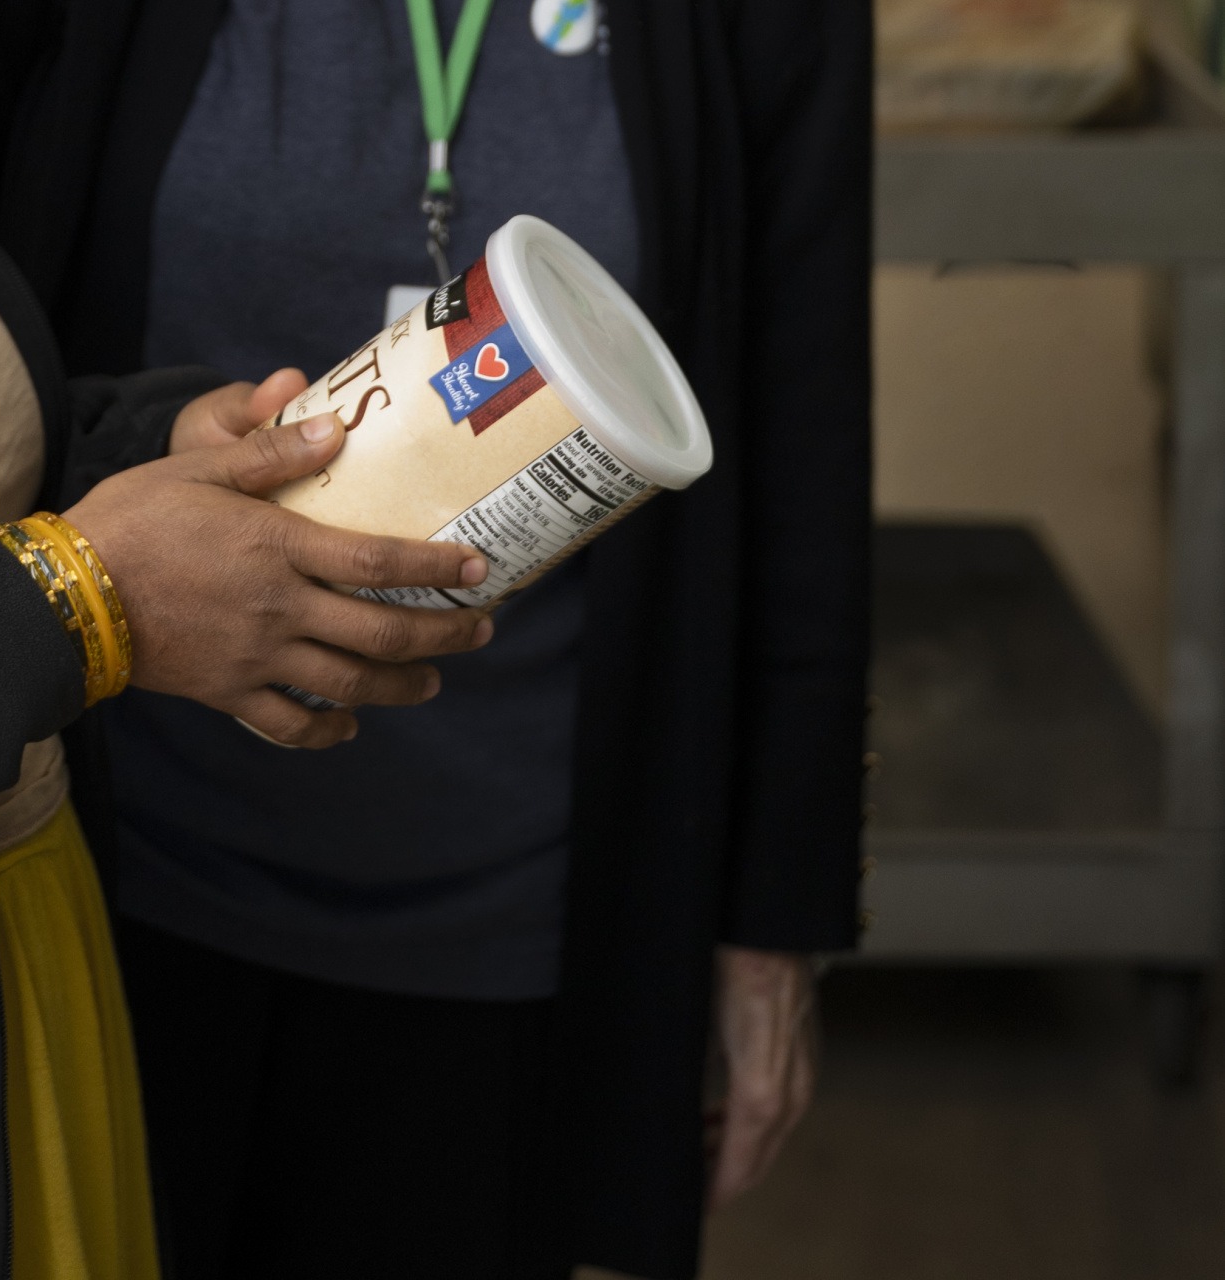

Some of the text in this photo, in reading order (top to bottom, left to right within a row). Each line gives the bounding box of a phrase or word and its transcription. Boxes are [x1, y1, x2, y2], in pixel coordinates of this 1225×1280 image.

[327, 336, 392, 432] ATS
[452, 362, 480, 402] Heart
[554, 445, 576, 470] Serving
[574, 466, 587, 479] size
[562, 440, 579, 457] about
[578, 455, 587, 464] 11
[585, 462, 608, 482] servings
[572, 429, 648, 491] Nutrition Facts
[509, 488, 532, 512] Saturated
[530, 509, 541, 519] Fat
[513, 477, 527, 493] Total
[525, 490, 537, 501] Fat
[531, 461, 572, 502] Calories
[583, 504, 610, 521] 160
[471, 507, 501, 539] Cholesterol
[502, 495, 515, 510] Trans
[514, 508, 524, 519] Fat
[455, 519, 470, 539] Total
[464, 513, 483, 537] Sodium
